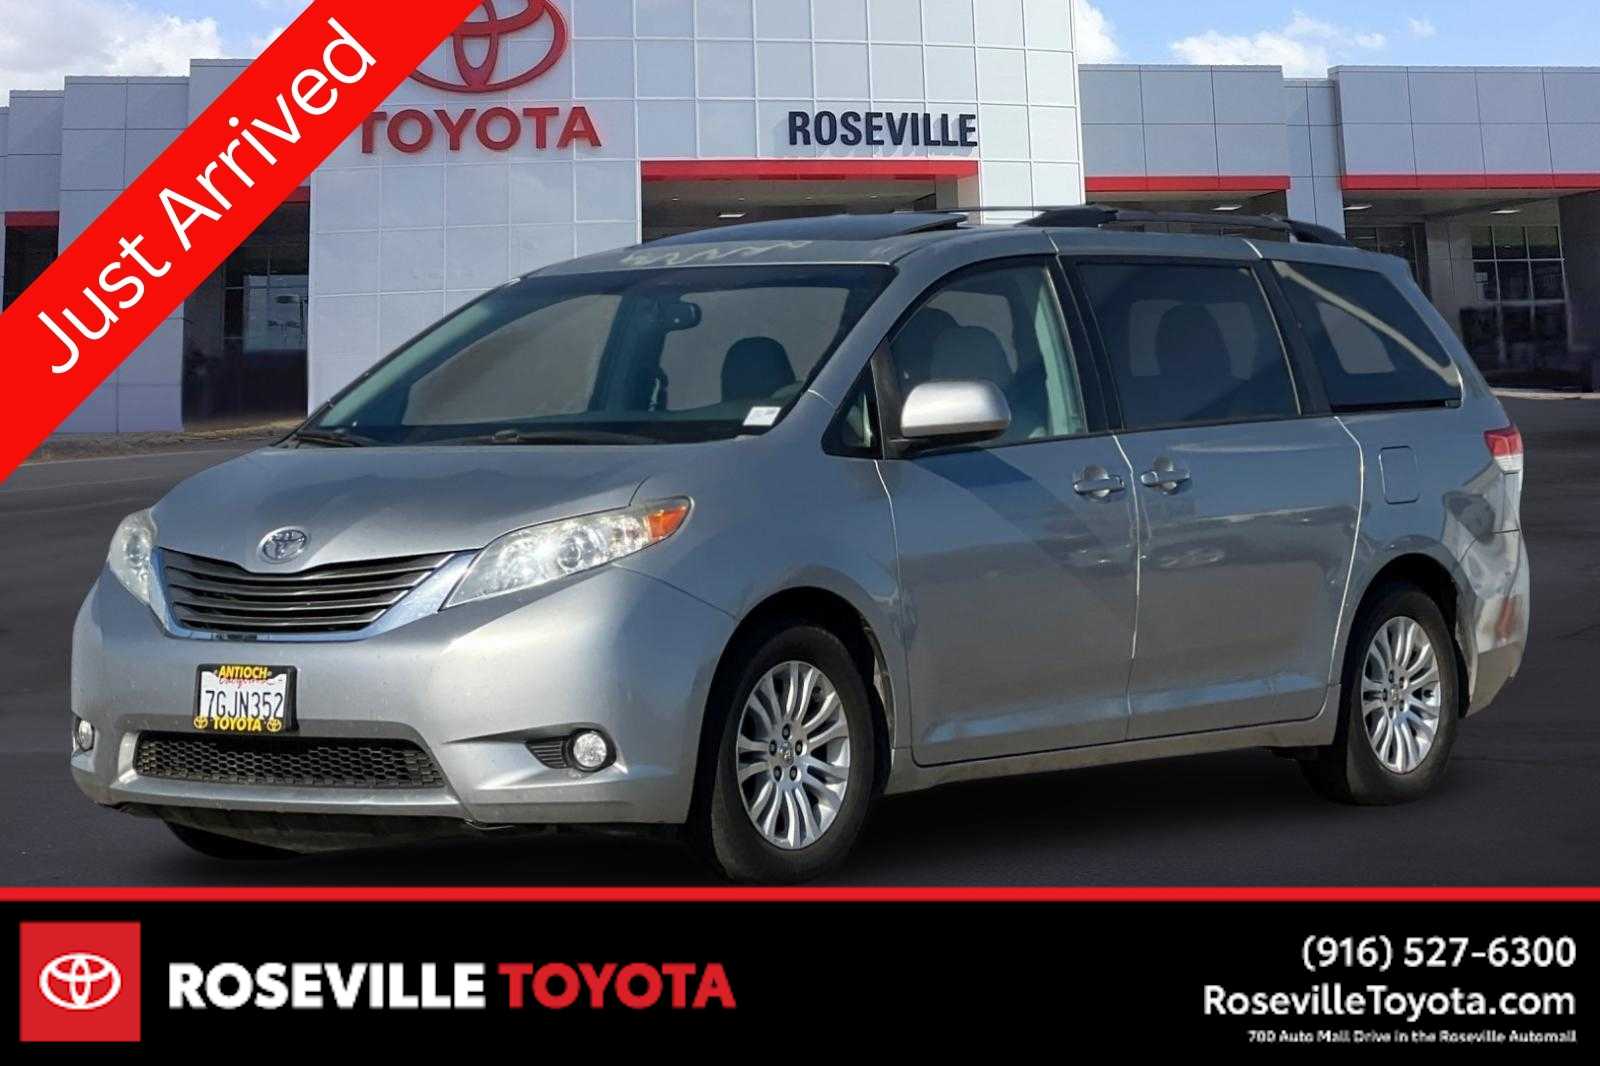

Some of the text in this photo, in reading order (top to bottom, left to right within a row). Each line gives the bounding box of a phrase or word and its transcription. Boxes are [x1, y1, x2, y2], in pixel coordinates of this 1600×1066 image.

[361, 106, 602, 154] TOYOTA
[788, 110, 978, 147] ROSEVILLE
[219, 665, 268, 679] ANTIOCH
[205, 690, 284, 719] 7GJN352
[213, 717, 262, 731] TOYOTA
